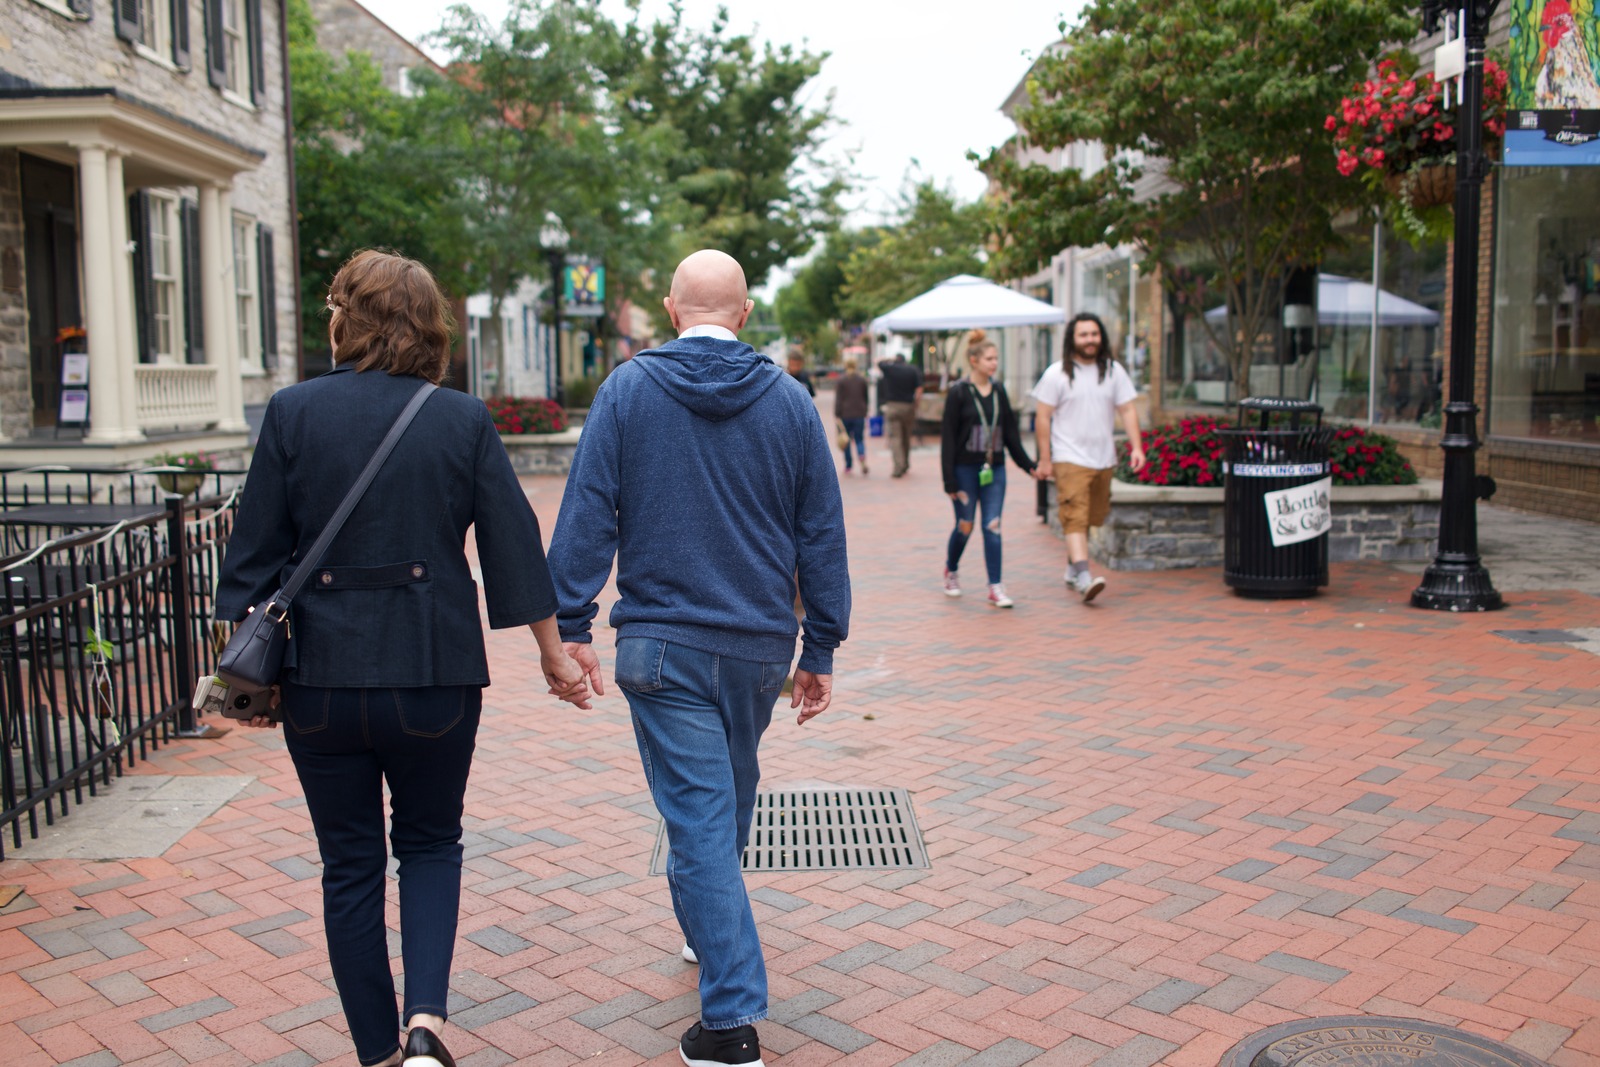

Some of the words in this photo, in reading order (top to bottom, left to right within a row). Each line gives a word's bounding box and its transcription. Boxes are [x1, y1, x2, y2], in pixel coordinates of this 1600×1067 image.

[1235, 464, 1295, 474] RECYCLING
[1299, 463, 1321, 473] ONLY
[1272, 1028, 1435, 1060] SANITARY
[1344, 1044, 1421, 1057] Founded
